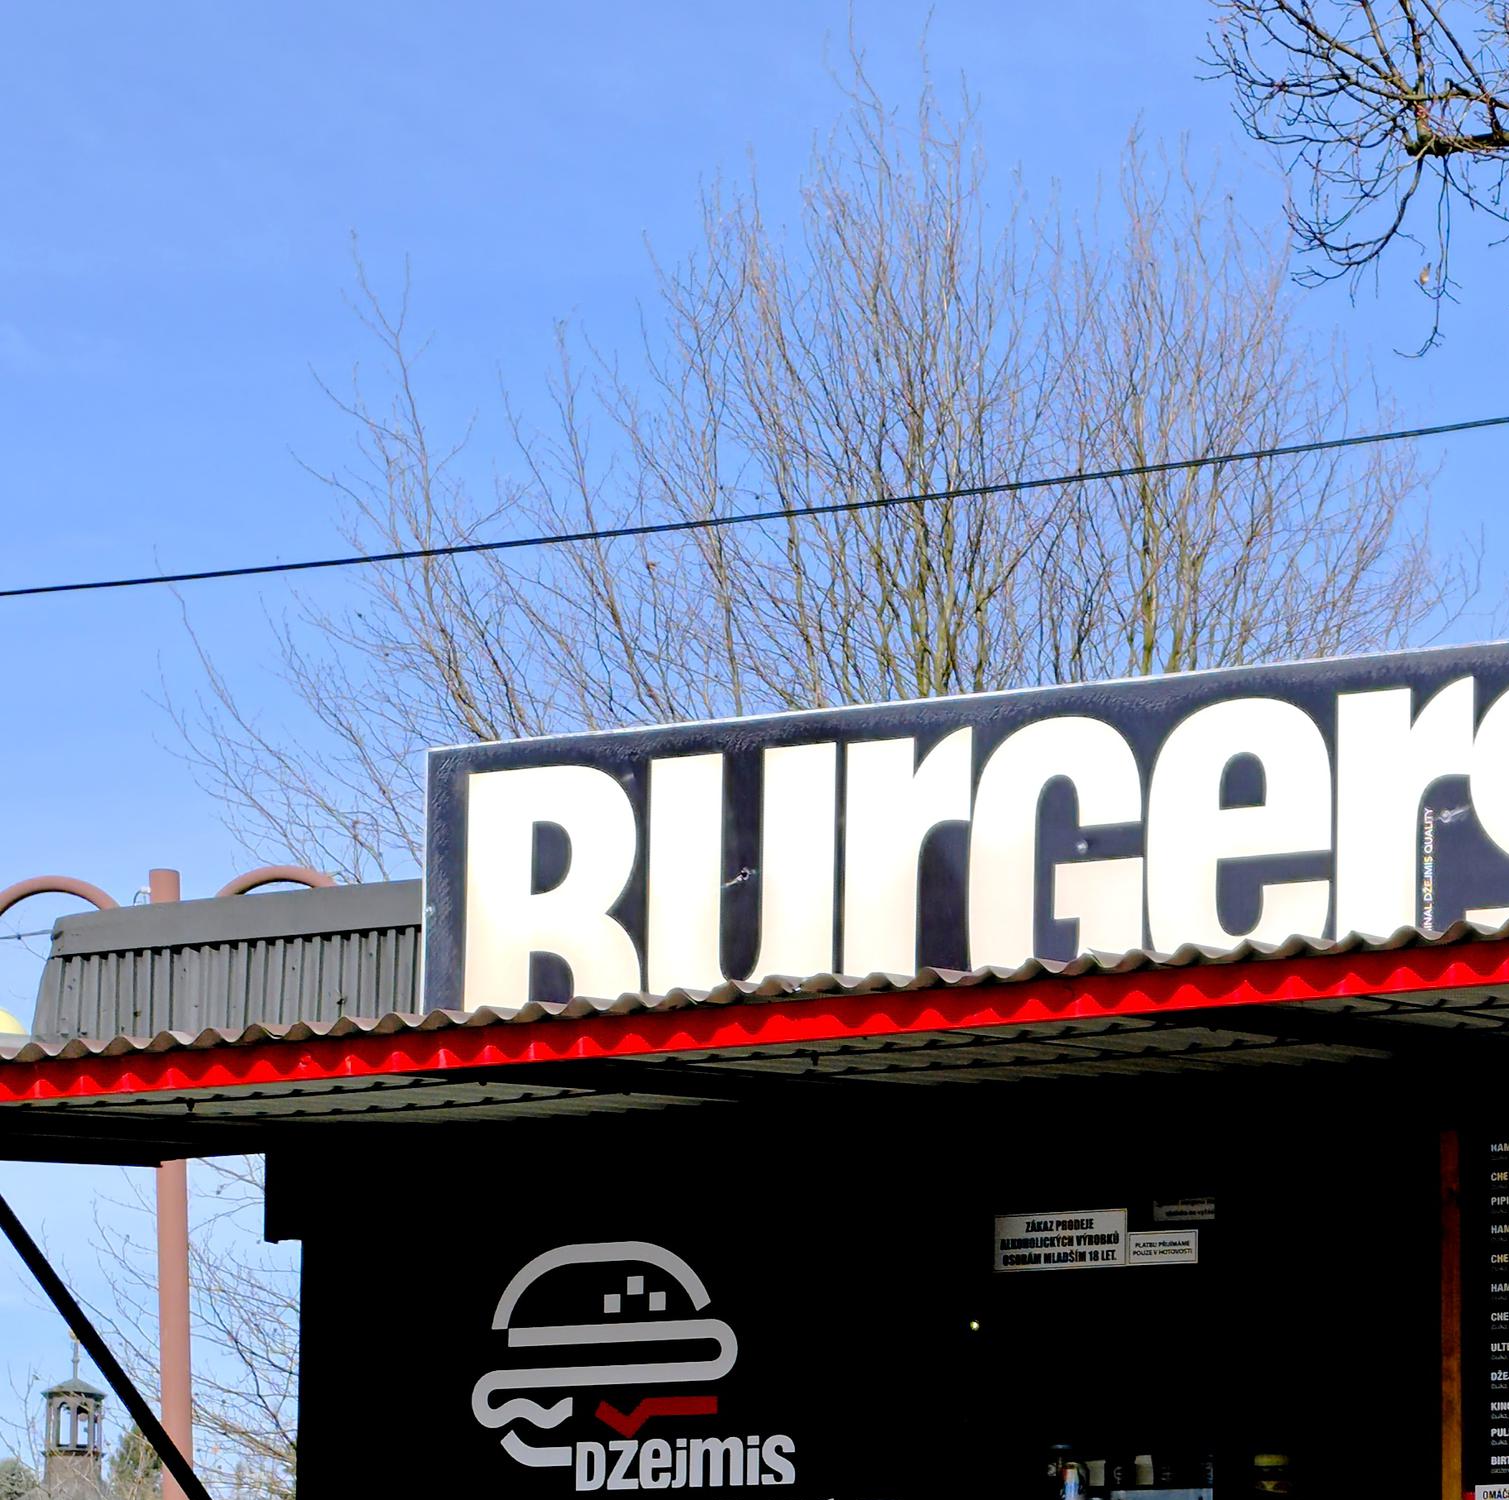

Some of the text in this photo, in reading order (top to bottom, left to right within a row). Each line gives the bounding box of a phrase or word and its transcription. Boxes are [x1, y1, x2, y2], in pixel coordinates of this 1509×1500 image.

[1424, 808, 1433, 853] QUALITY
[1491, 1196, 1509, 1205] PIPI
[1026, 1218, 1093, 1232] ZÁKAZ PRODEJE
[1000, 1231, 1119, 1250] ALKOHOLICKÝCH VÝROBKŮ
[1003, 1250, 1116, 1266] OSOBÁM MLADŠÍM 18 LET.
